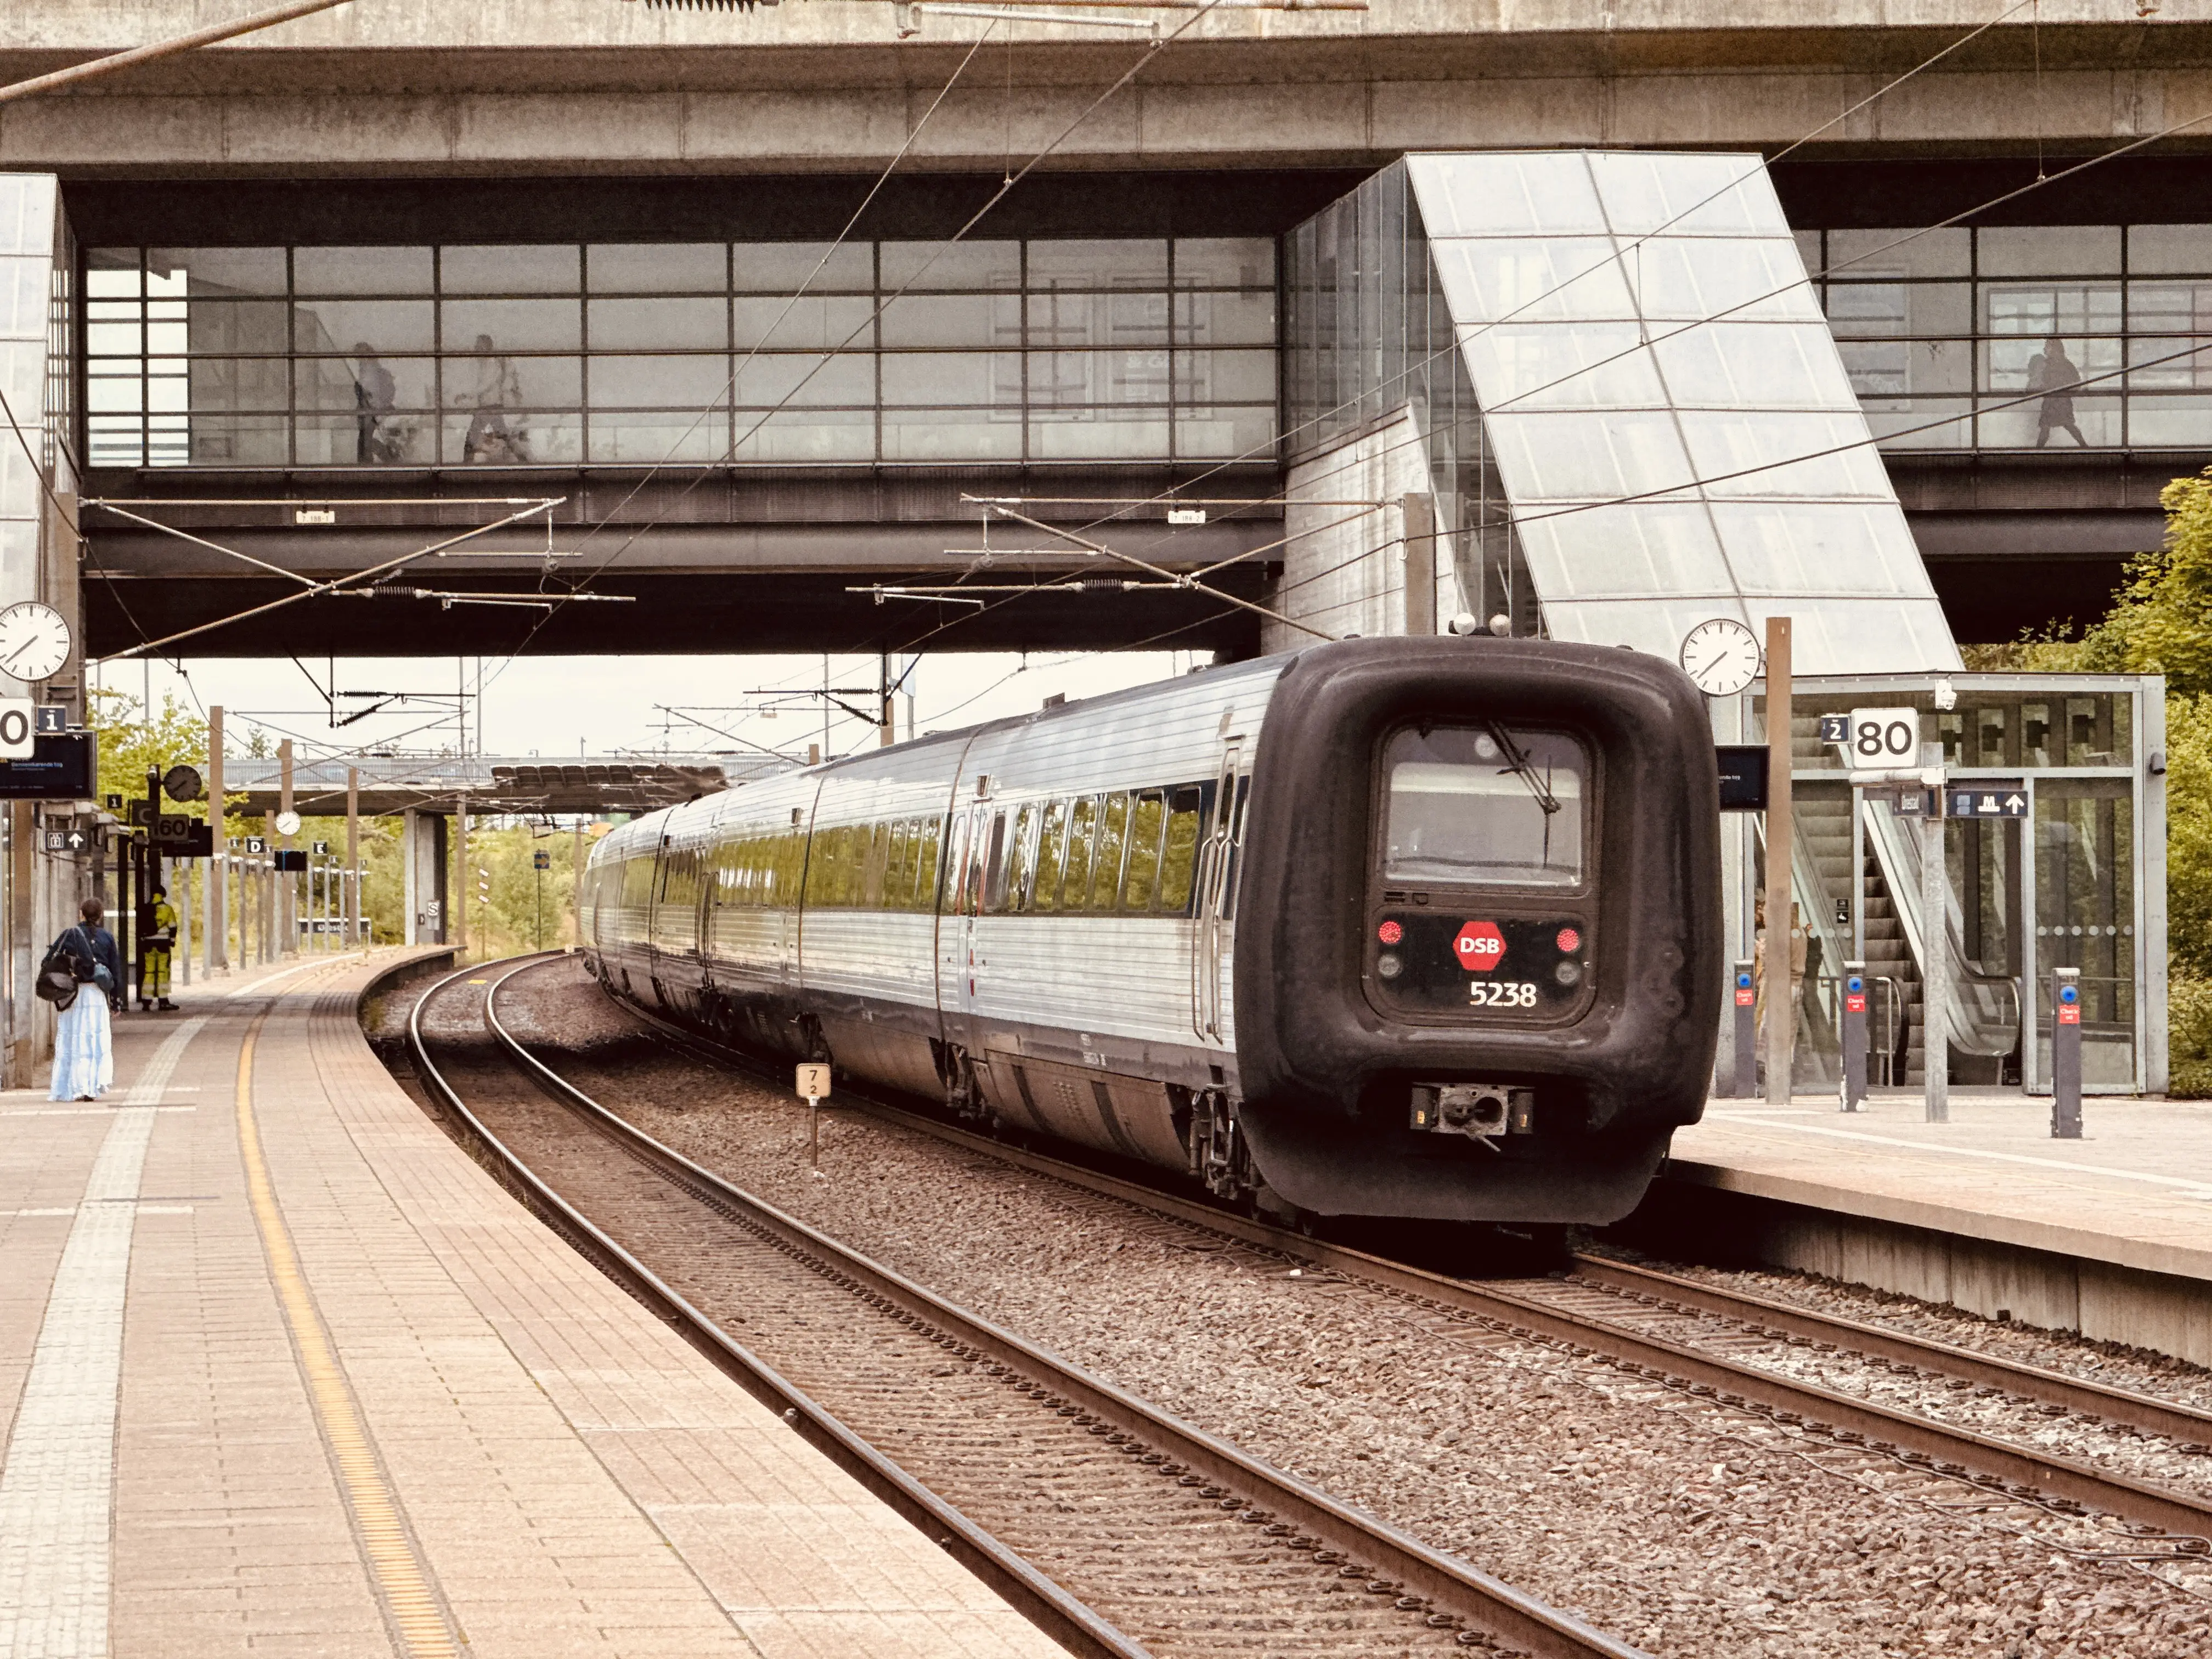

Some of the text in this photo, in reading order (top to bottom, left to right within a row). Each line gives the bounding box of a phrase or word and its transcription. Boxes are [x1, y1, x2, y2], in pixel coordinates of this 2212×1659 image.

[46, 714, 58, 731] 1
[1830, 723, 1842, 740] 2
[1857, 720, 1912, 756] 80
[111, 797, 119, 808] 1
[139, 807, 152, 824] C
[251, 840, 261, 853] D
[317, 844, 324, 854] E
[429, 904, 438, 915] S
[1460, 937, 1500, 954] DSB
[1470, 981, 1537, 1008] 5238
[809, 1069, 818, 1081] 7
[810, 1085, 817, 1094] 2
